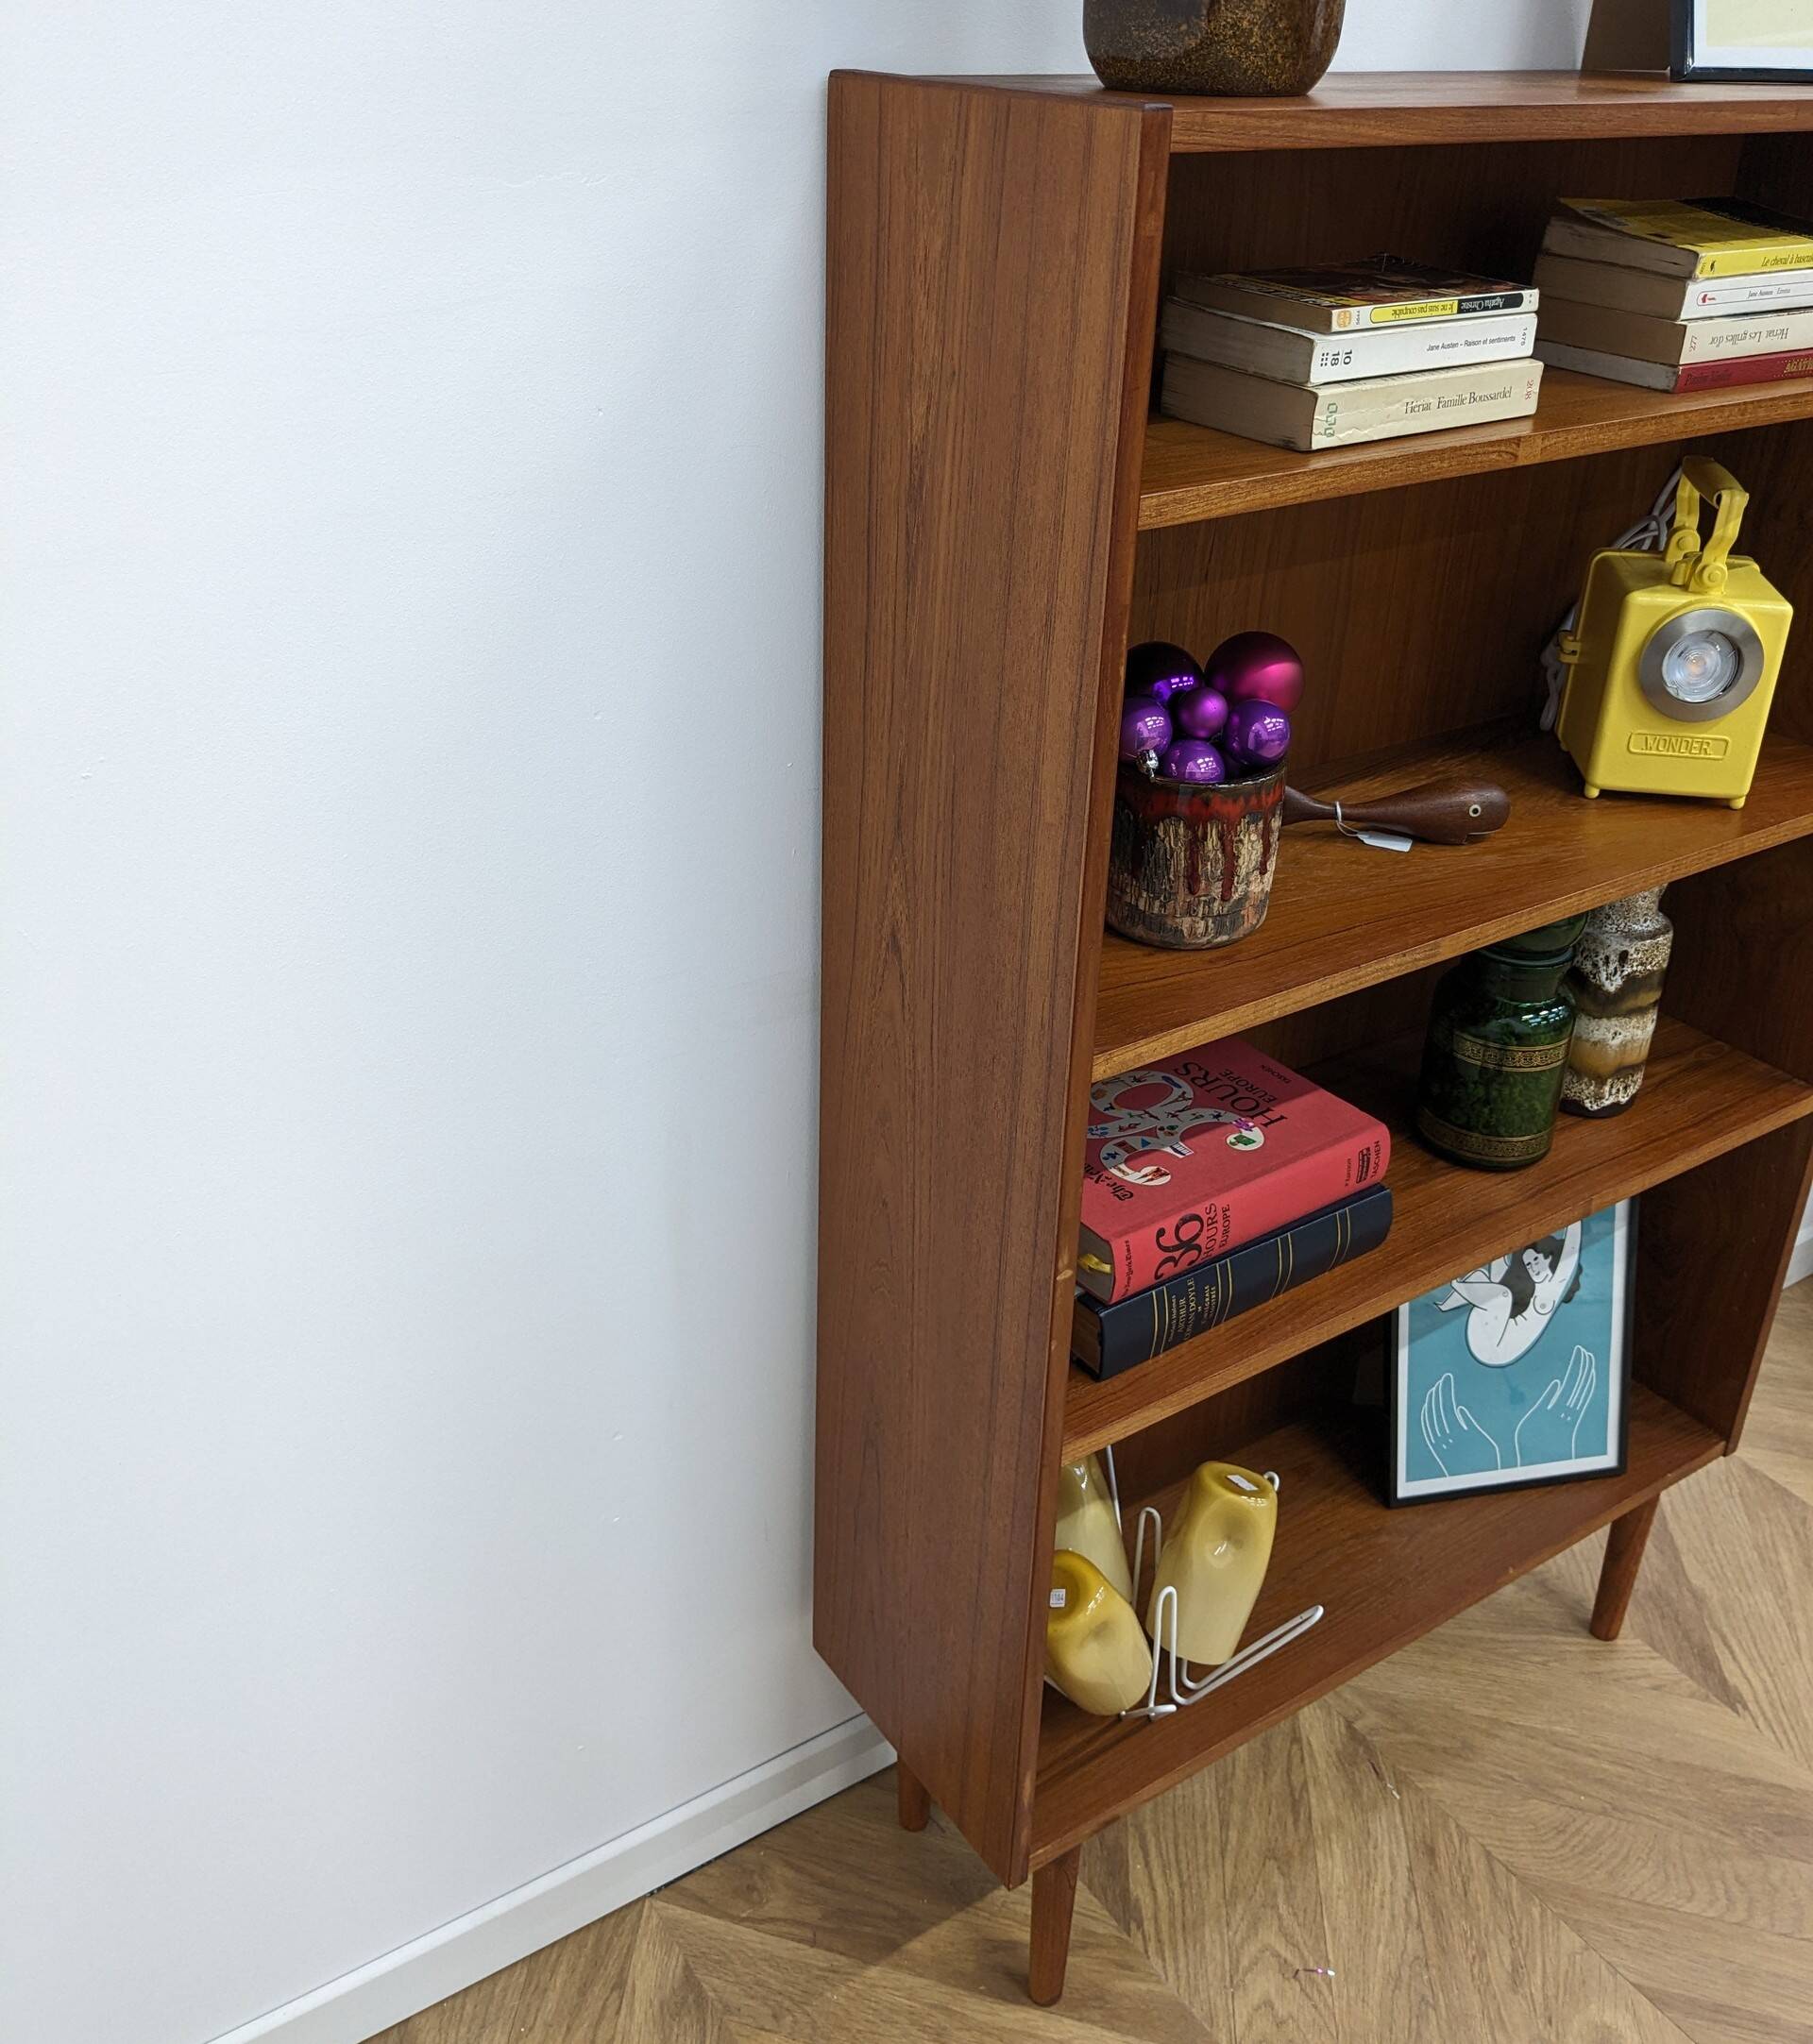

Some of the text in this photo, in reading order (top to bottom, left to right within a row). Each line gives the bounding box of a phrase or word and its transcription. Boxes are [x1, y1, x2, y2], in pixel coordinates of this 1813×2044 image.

[1417, 304, 1429, 313] pas
[1428, 304, 1441, 314] suis
[1448, 301, 1455, 313] Je
[1460, 300, 1485, 313] Christie
[1484, 296, 1505, 309] Agatha
[1391, 306, 1417, 318] coupable
[1725, 329, 1749, 346] grilles
[1749, 330, 1764, 344] Les
[1766, 328, 1789, 341] Hériat
[1427, 344, 1440, 352] Jane
[1440, 341, 1459, 350] Austen
[1464, 339, 1483, 347] Raison
[1488, 335, 1516, 345] sentiments
[1330, 351, 1341, 367] 18
[1343, 348, 1352, 365] 10
[1524, 379, 1534, 400] 208
[1404, 385, 1514, 414] Hériat Famille Boussardel
[1174, 1061, 1288, 1128] HOURS
[1219, 1068, 1278, 1104] EUROPE
[1369, 1140, 1381, 1179] TASCHEN
[1200, 1202, 1217, 1261] HOURS
[1219, 1204, 1230, 1249] EUROPE
[1154, 1212, 1205, 1281] 36
[1187, 1276, 1196, 1311] DOYLE
[1178, 1296, 1187, 1332] ARTHUR
